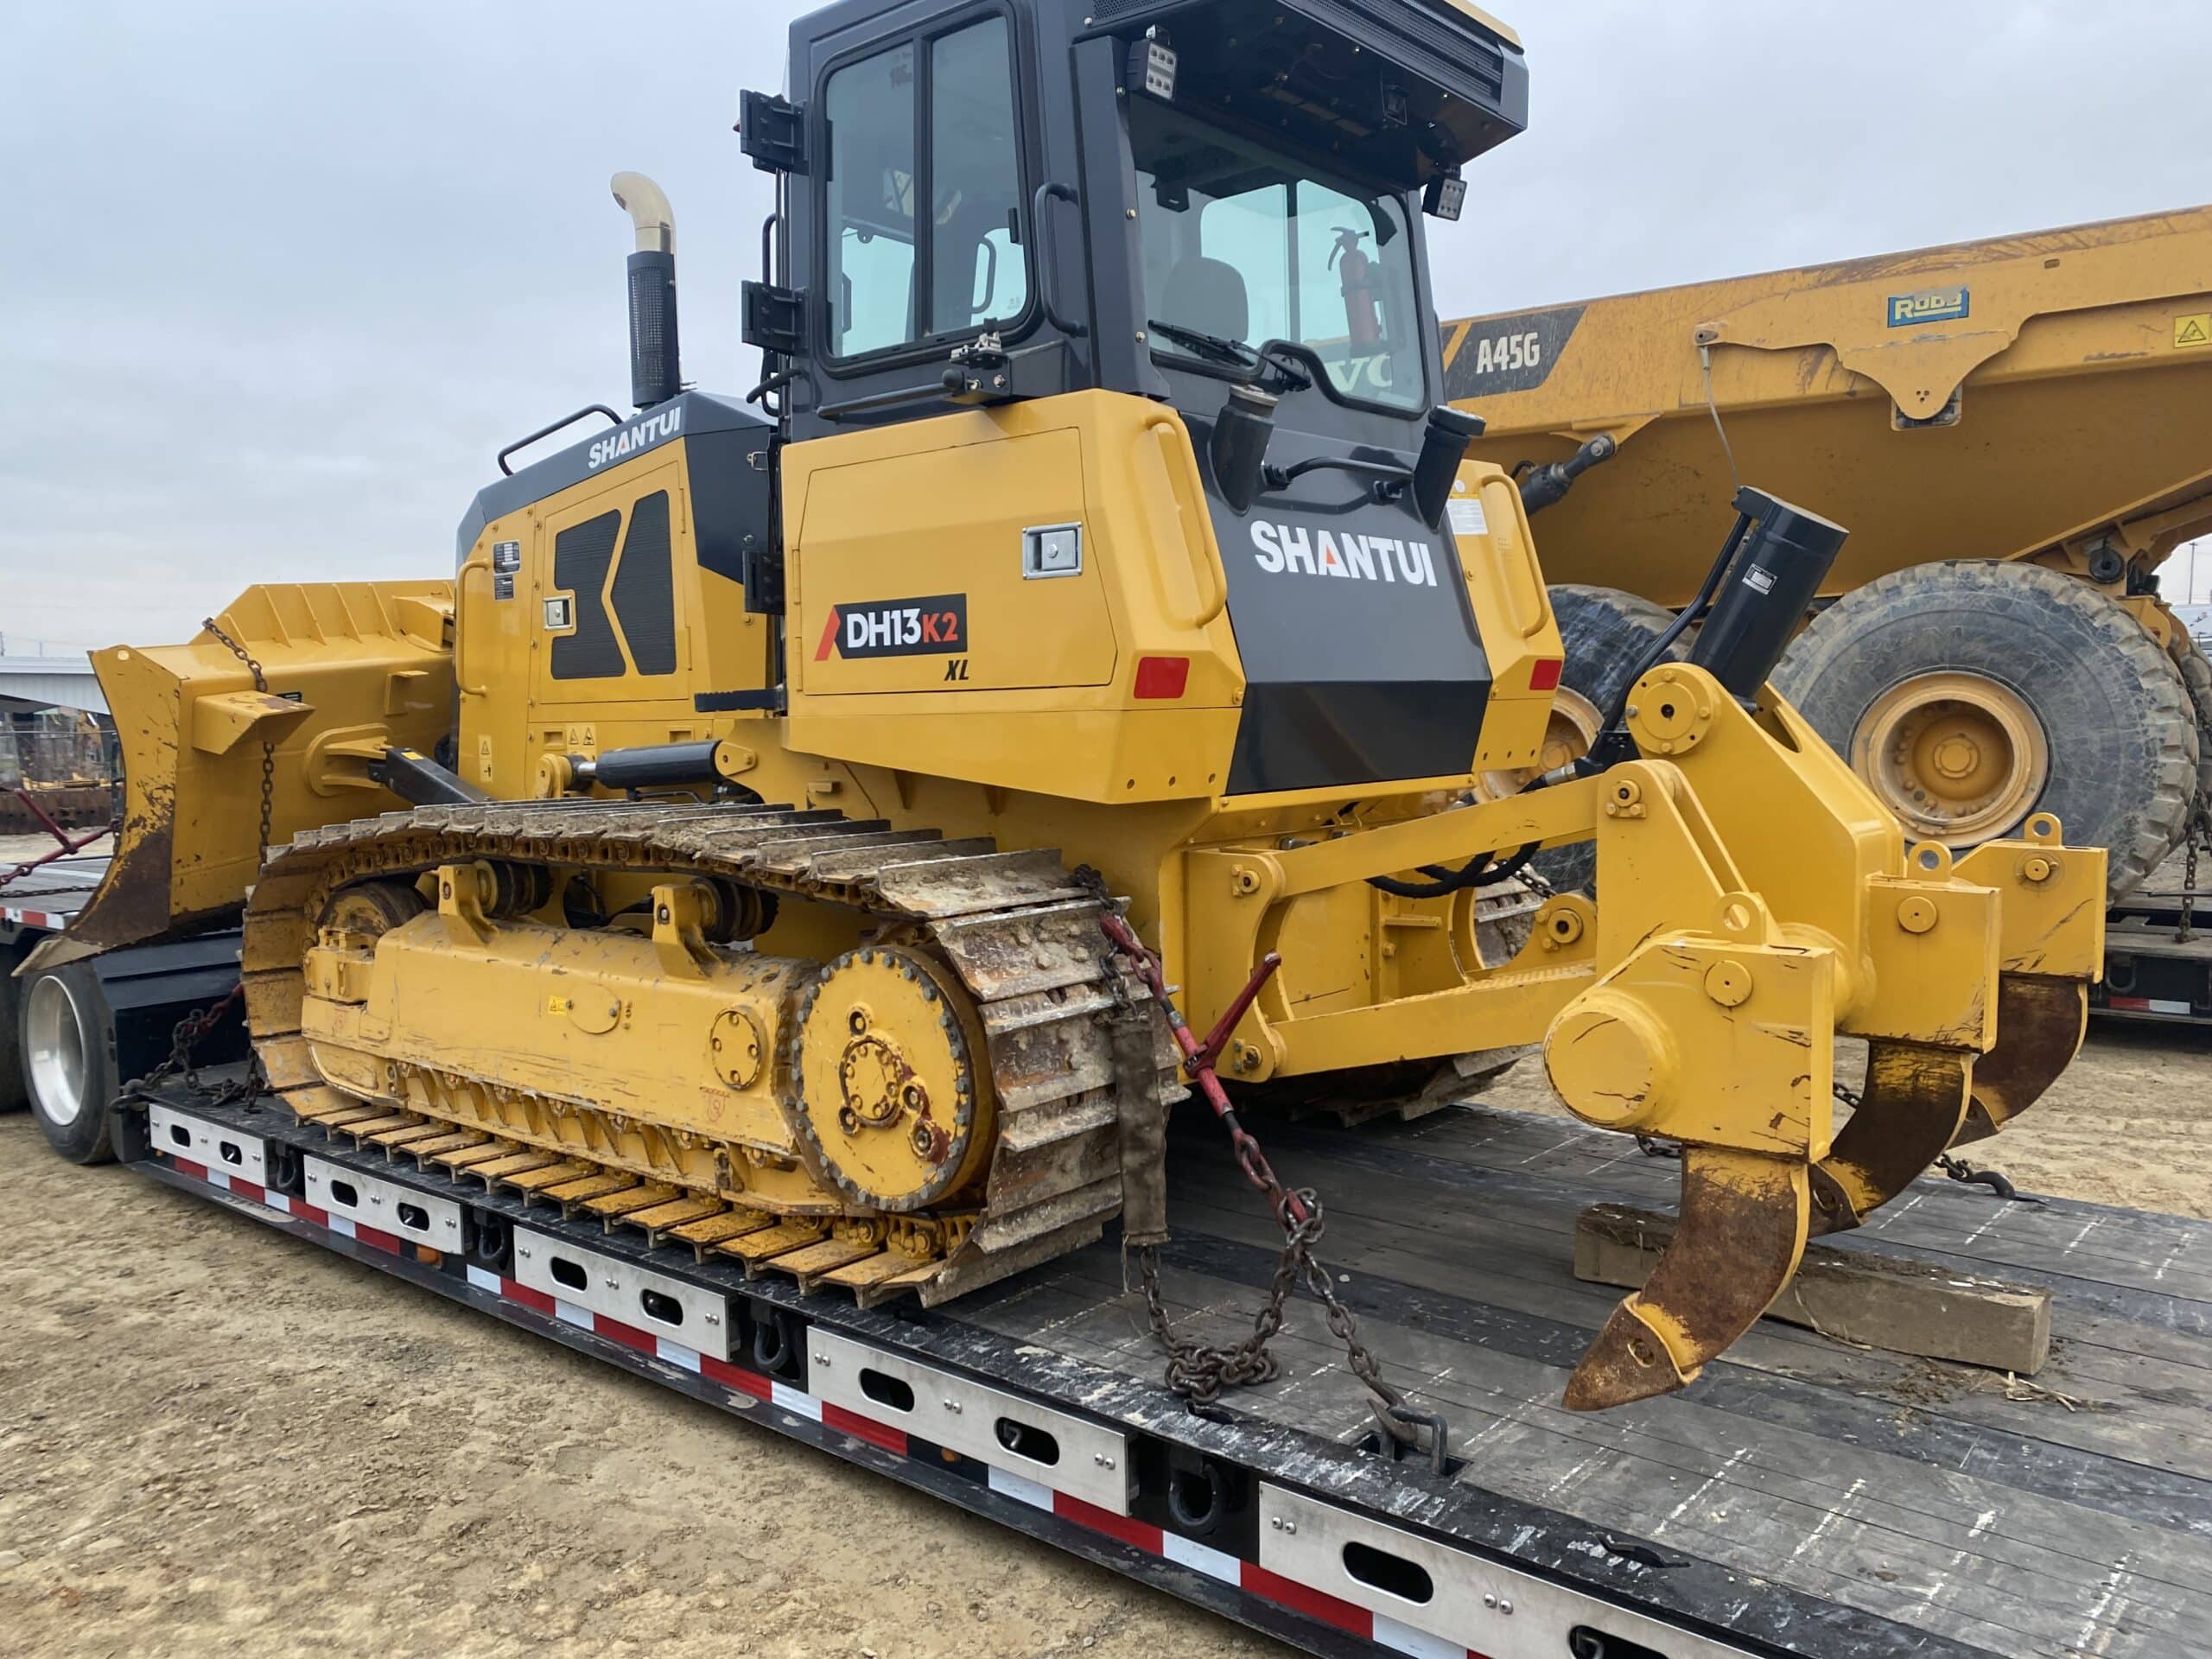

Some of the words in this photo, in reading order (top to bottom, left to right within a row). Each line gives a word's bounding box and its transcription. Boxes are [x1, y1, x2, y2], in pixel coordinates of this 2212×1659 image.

[1476, 332, 1541, 374] A45G
[588, 406, 681, 468] SHANTUI
[1250, 520, 1438, 587] SHANTUI
[846, 607, 959, 649] DH13K2
[944, 659, 969, 681] XL
